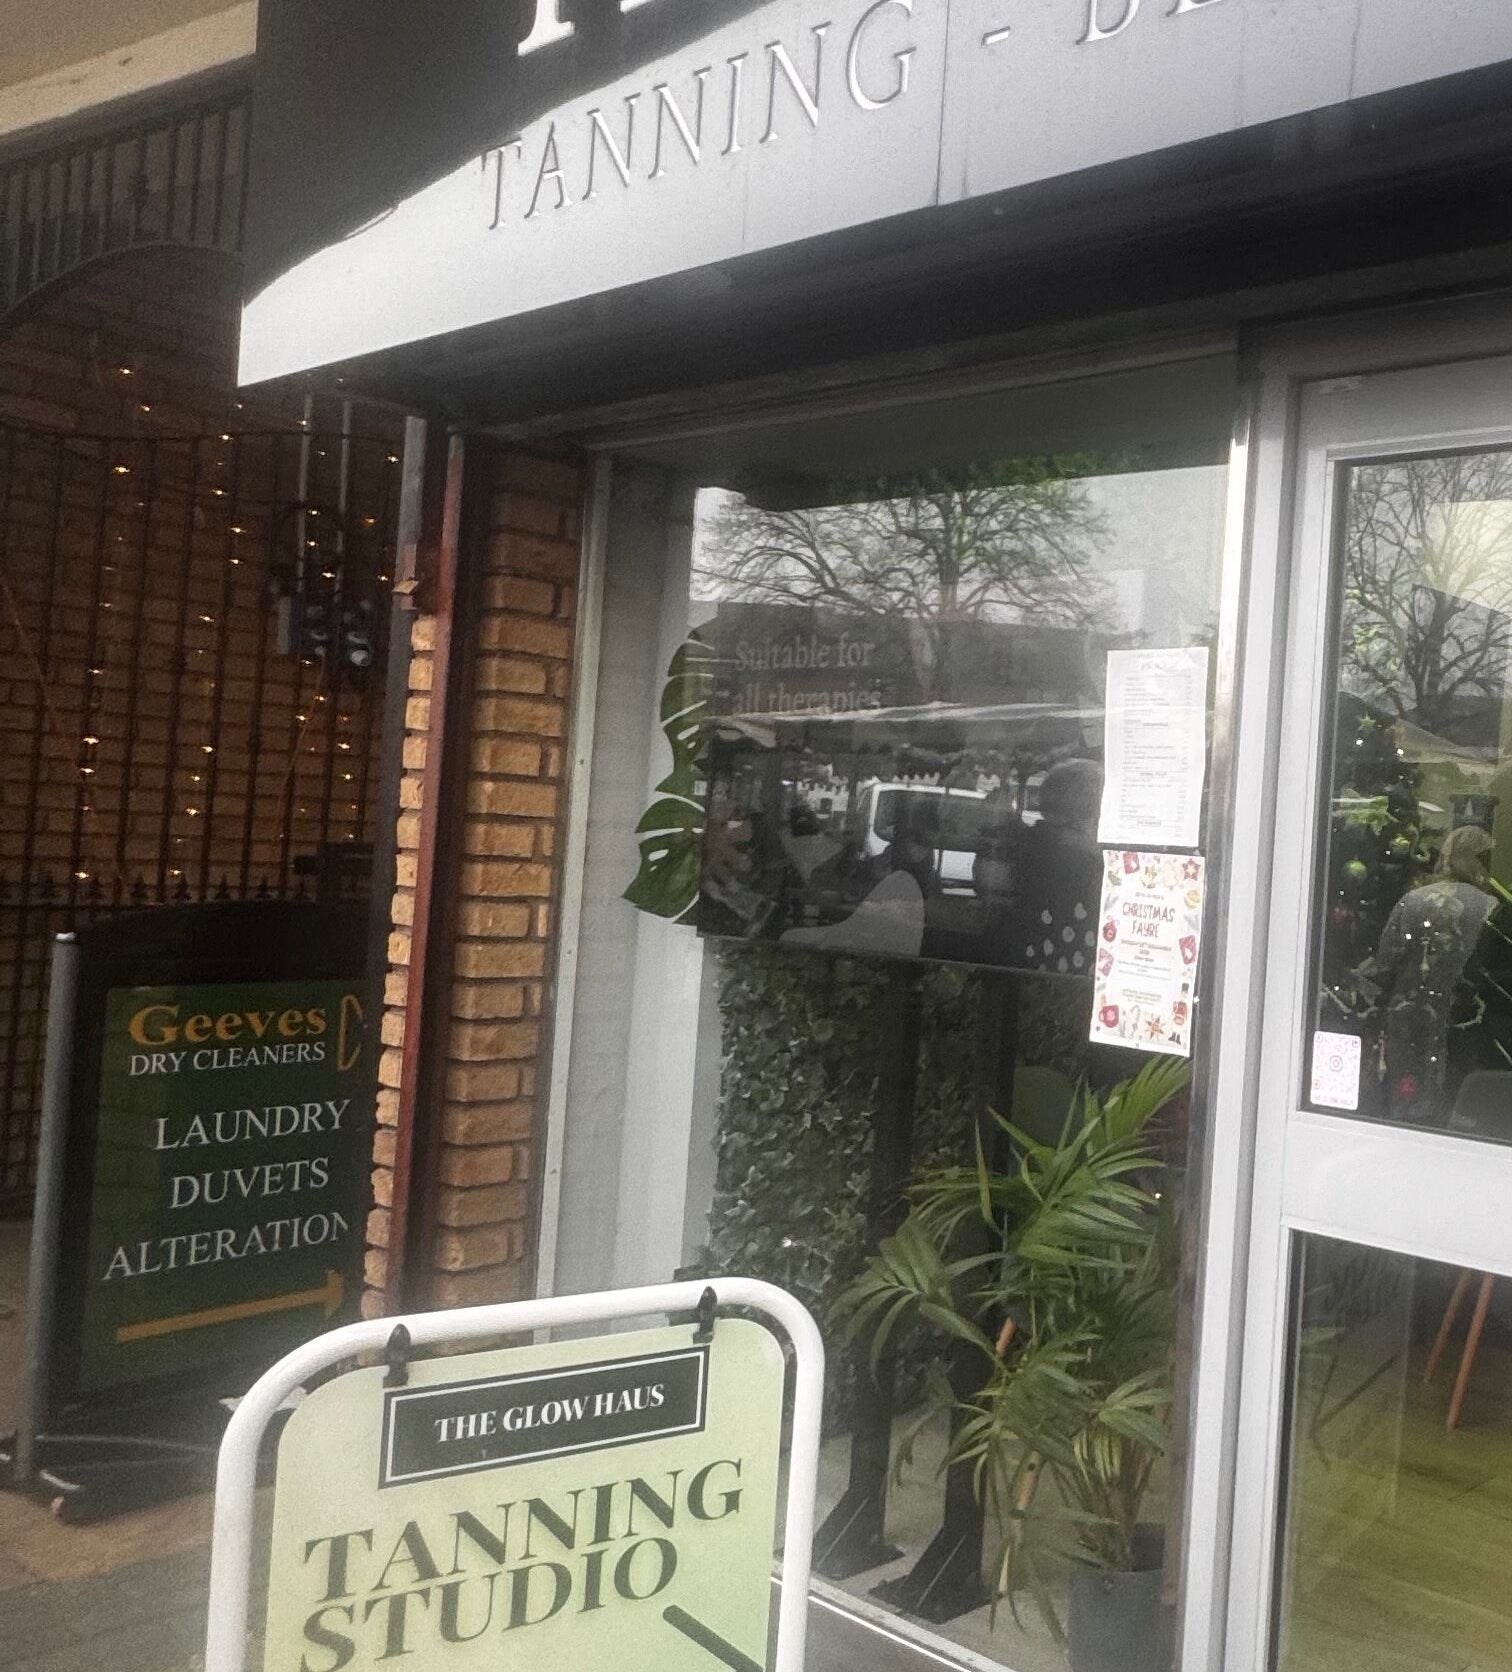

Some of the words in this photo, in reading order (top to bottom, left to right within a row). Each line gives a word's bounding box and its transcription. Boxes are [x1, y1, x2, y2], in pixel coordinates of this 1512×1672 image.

[480, 0, 917, 230] TANNING
[734, 634, 830, 671] Suitable
[836, 631, 876, 667] for
[1122, 901, 1176, 923] CHRISTMAS
[1131, 918, 1160, 938] FAYRE
[127, 1004, 328, 1046] Geeves
[128, 1050, 188, 1077] DRY
[193, 1042, 327, 1071] CLEANERS
[154, 1099, 352, 1151] LAUNDRY
[168, 1156, 330, 1210] DUVETS
[434, 1409, 497, 1445] THE
[502, 1396, 591, 1432] GLOW
[592, 1384, 666, 1418] HAUS
[303, 1458, 744, 1601] TANNING
[301, 1536, 678, 1672] STUDIO
